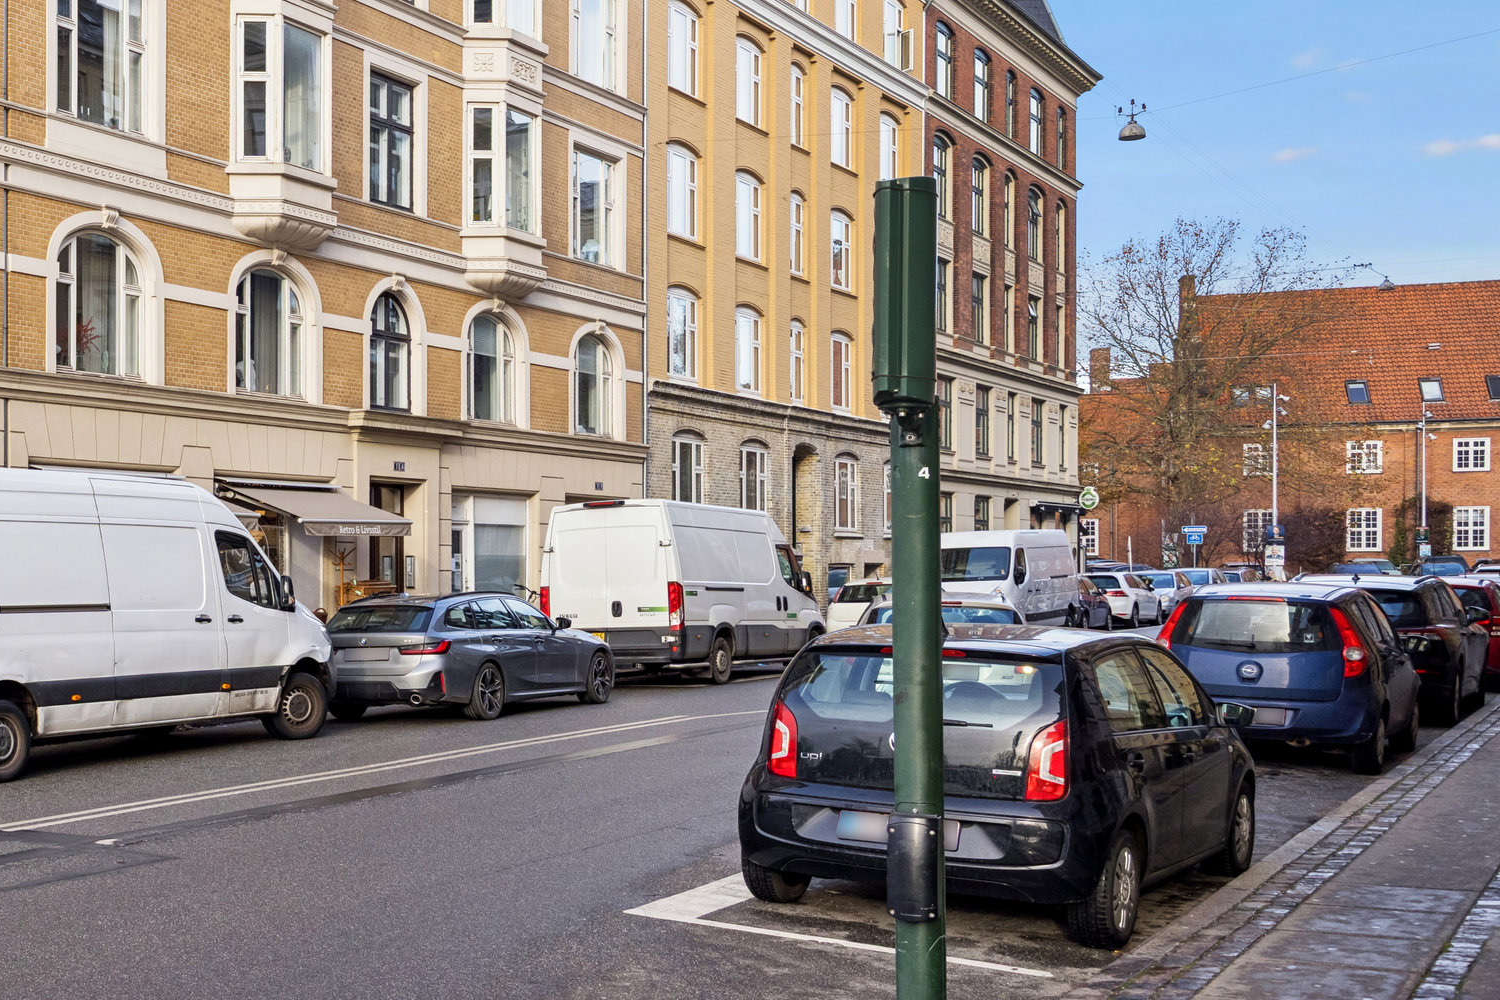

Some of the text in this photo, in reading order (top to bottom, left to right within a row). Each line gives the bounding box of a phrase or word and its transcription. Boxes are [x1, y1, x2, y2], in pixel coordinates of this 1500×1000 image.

[918, 466, 930, 479] 4
[339, 525, 381, 534] Retro & Livsstil
[800, 752, 822, 760] up!
